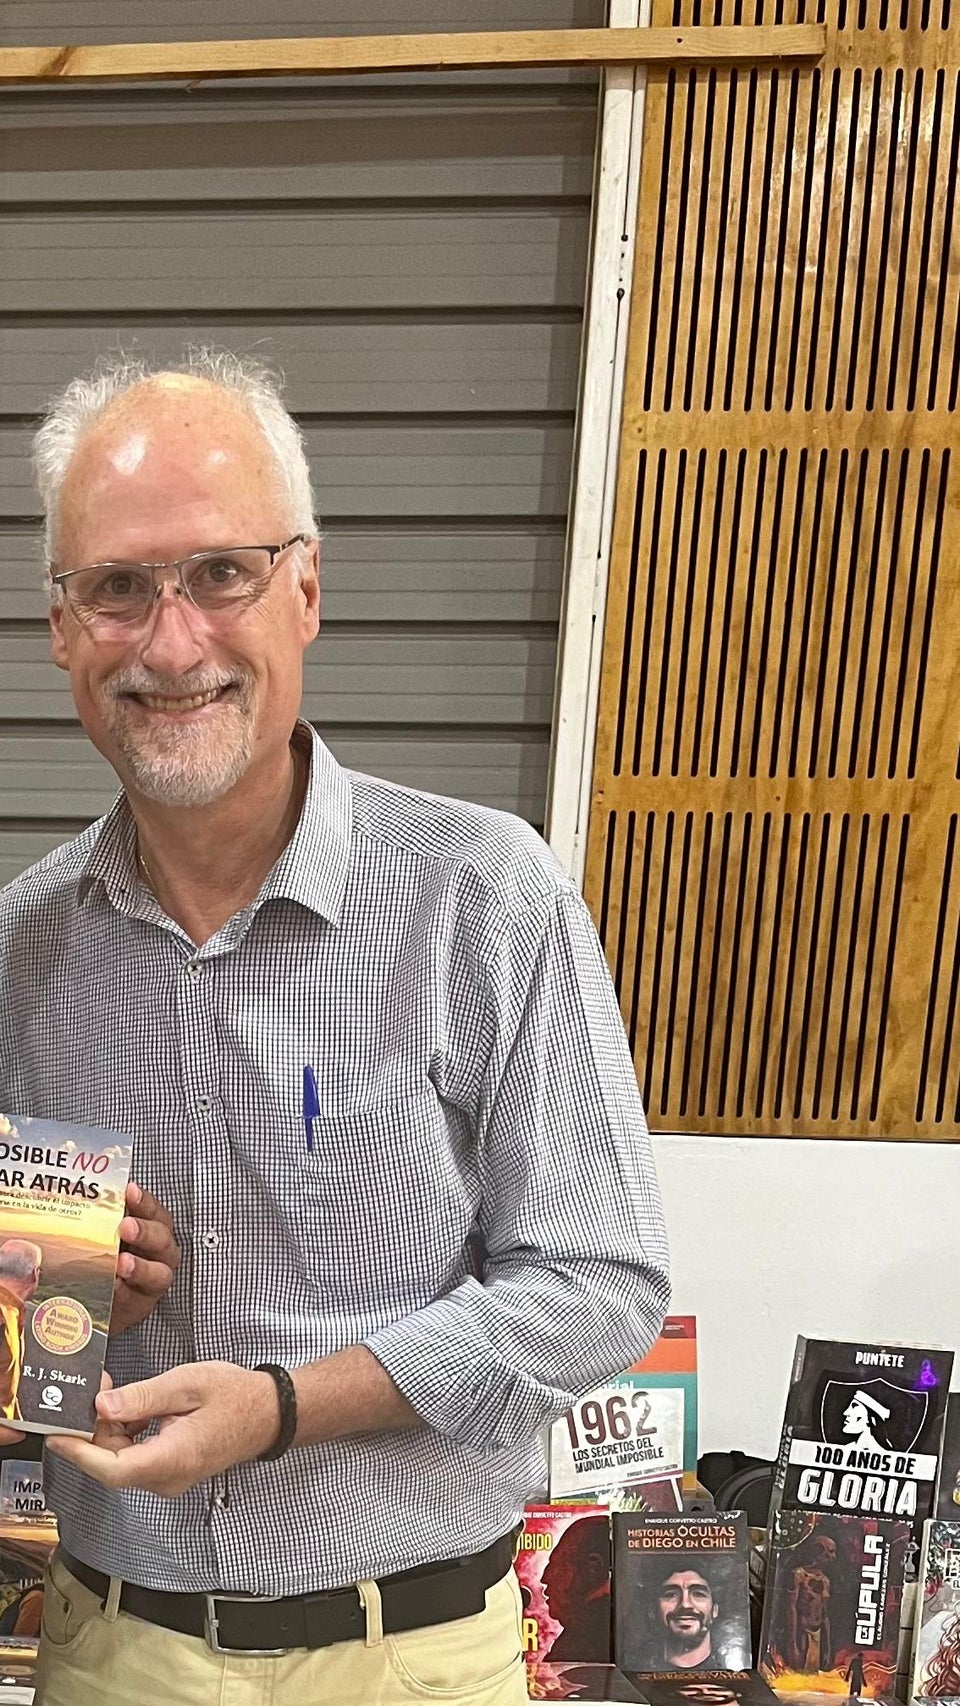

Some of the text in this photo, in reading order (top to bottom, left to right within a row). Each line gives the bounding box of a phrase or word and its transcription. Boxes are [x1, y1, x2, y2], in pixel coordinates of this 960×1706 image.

[72, 1151, 110, 1174] NO
[29, 1173, 100, 1199] ATRÁS
[31, 1202, 47, 1211] vida
[61, 1199, 91, 1209] impacto
[23, 1365, 35, 1378] R.
[37, 1367, 47, 1381] J.
[563, 1390, 657, 1449] 1962
[572, 1437, 654, 1462] LOS SECRETOS DEL
[575, 1447, 665, 1474] MUNDIAL IMPOSIBLE
[814, 1445, 917, 1475] 100 AÑOS DE
[797, 1468, 918, 1517] GLORIA
[627, 1528, 675, 1538] HISTORIAS
[628, 1537, 736, 1548] DE DIEGO EN CHILE
